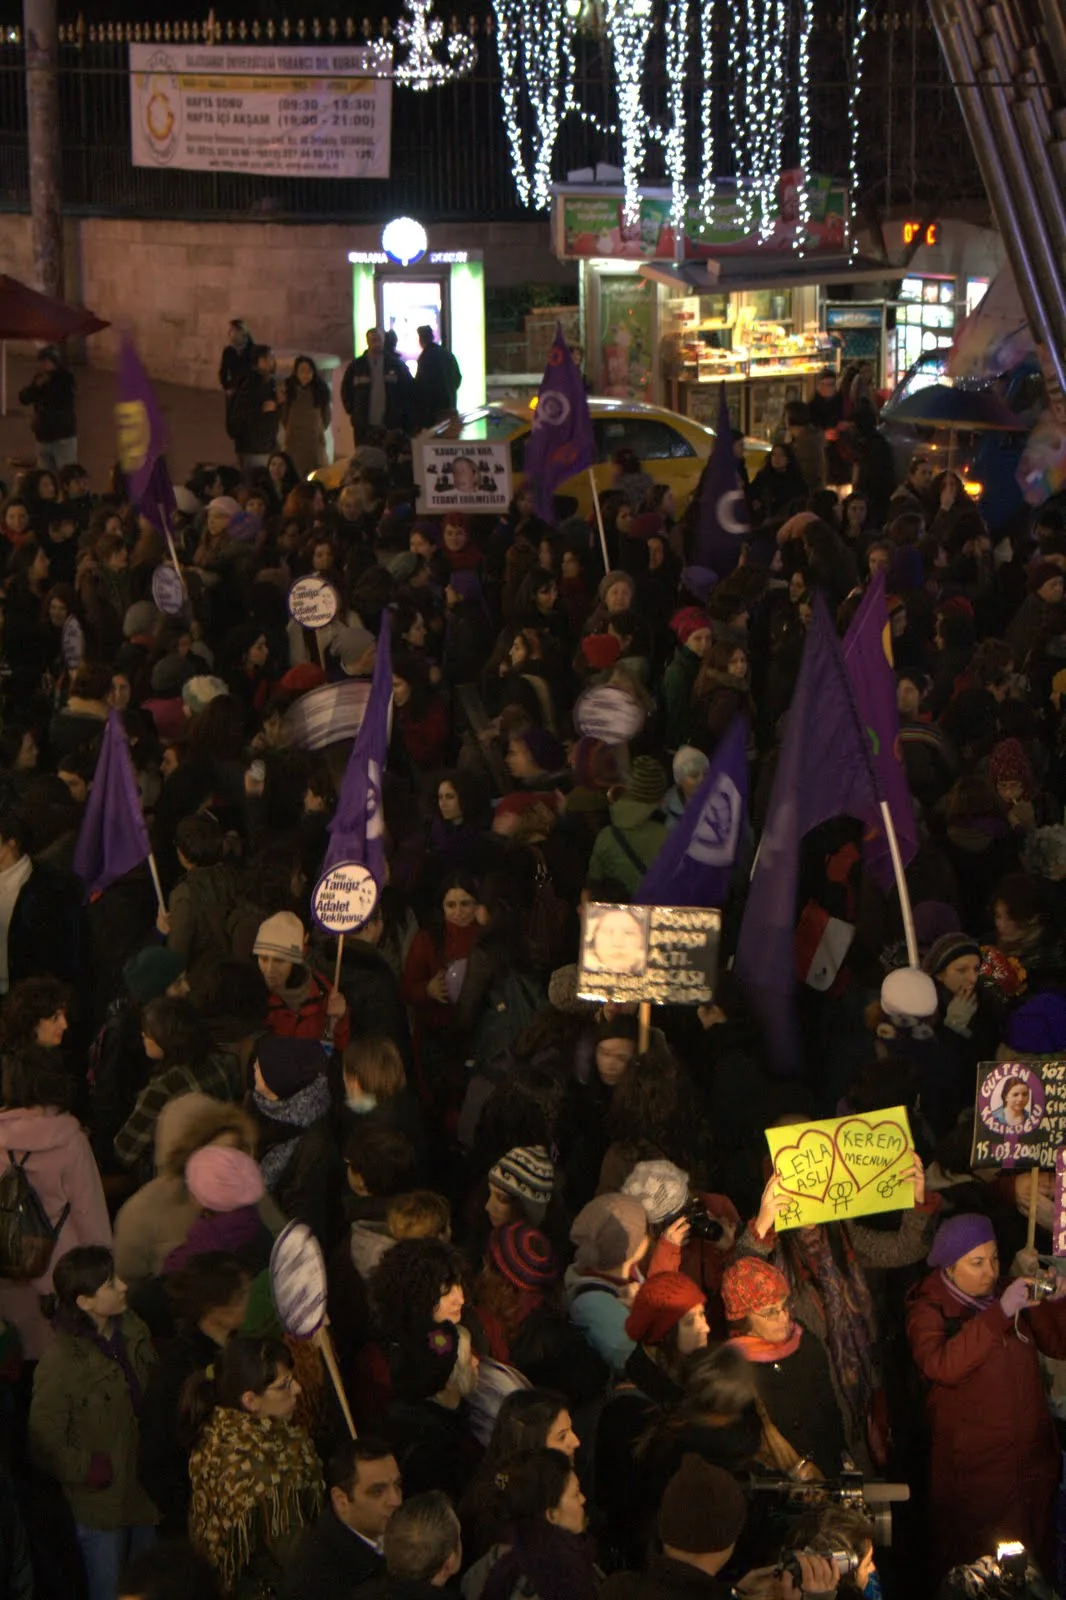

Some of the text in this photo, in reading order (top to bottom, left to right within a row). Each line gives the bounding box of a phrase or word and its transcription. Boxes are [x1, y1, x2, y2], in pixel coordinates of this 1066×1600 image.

[324, 877, 361, 893] Tanığız
[316, 900, 350, 912] Adalet
[320, 912, 364, 925] Bekliyoruz
[981, 1063, 1031, 1098] GÜLTEN
[842, 1130, 902, 1151] KEREM
[778, 1143, 832, 1182] LEYLA
[843, 1152, 893, 1167] MECNUN
[796, 1166, 830, 1191] ASLI
